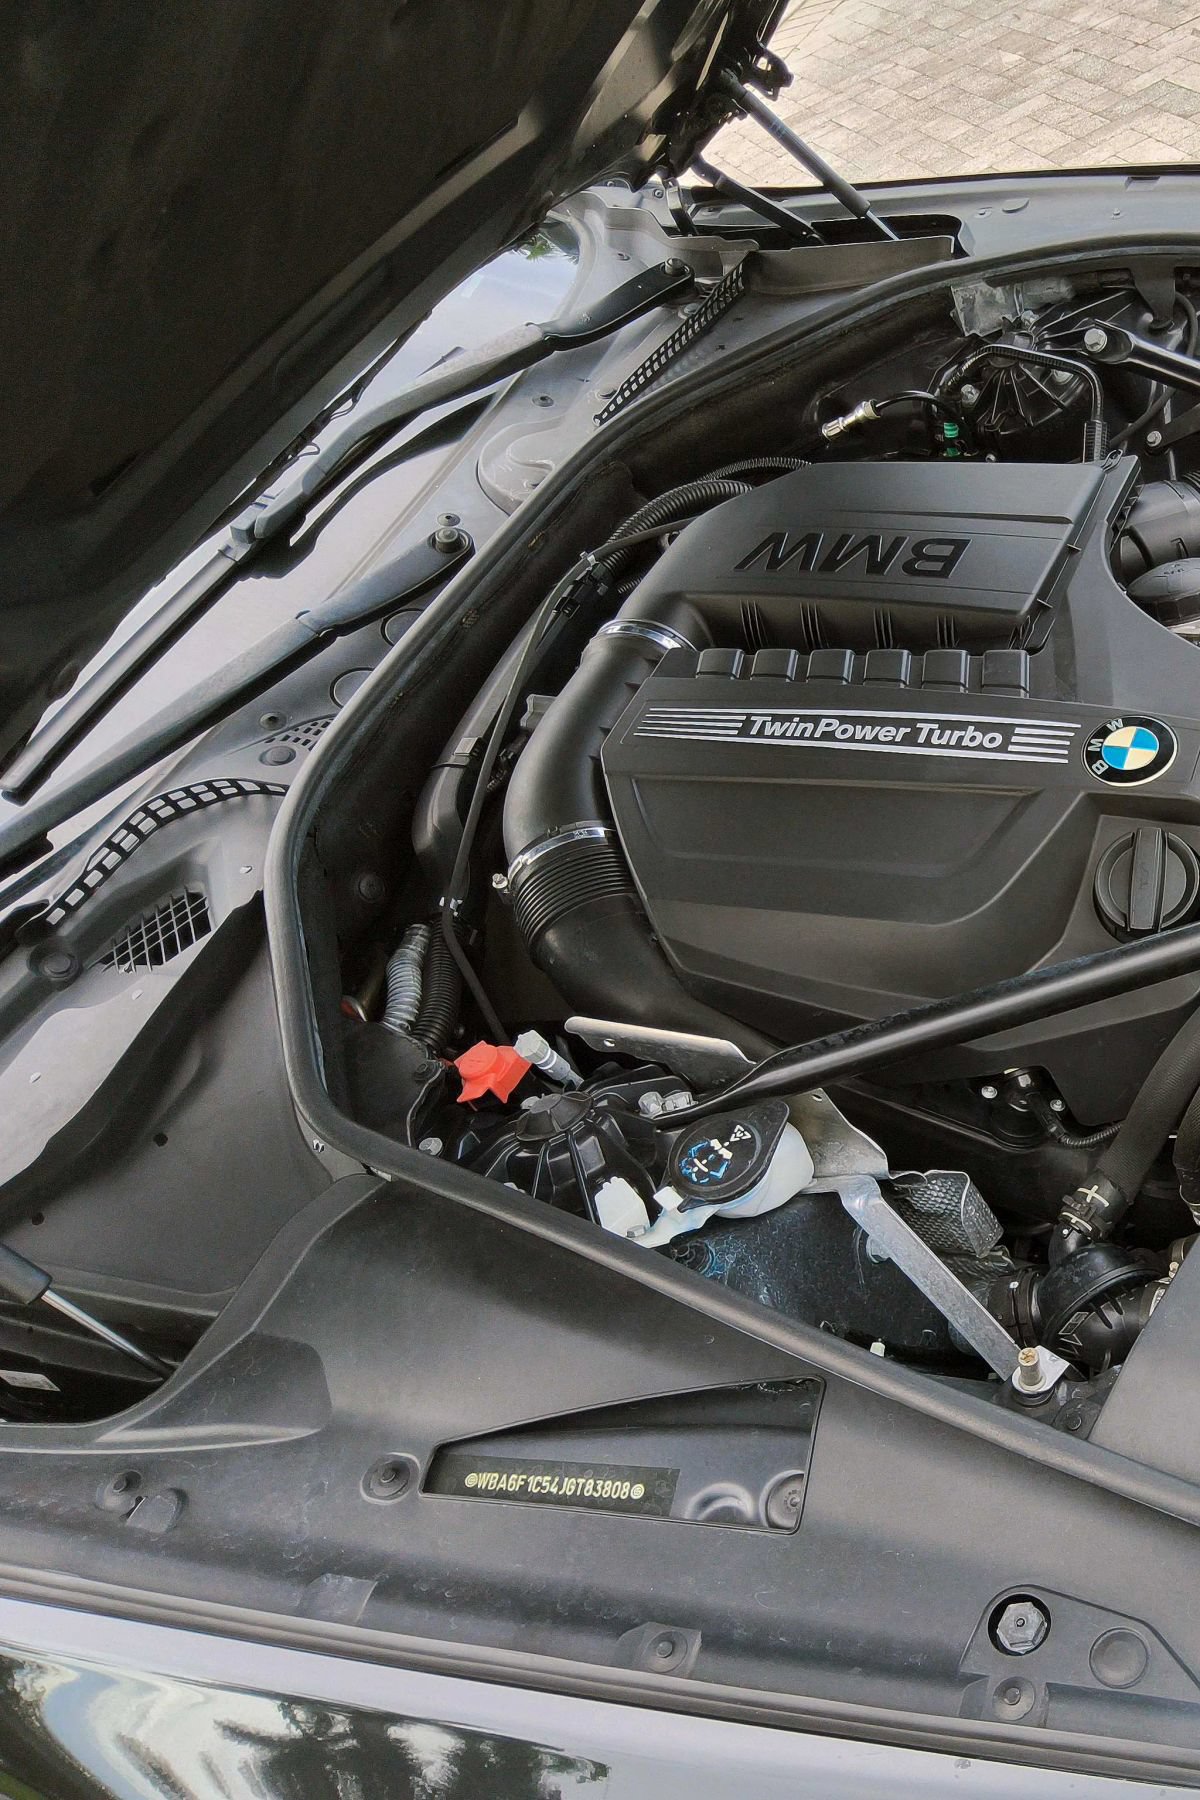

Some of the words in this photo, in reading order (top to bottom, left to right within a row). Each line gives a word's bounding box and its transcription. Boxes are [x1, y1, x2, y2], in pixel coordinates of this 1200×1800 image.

[734, 532, 972, 578] BMW
[916, 723, 1002, 749] Turbo
[1087, 718, 1124, 775] BMW
[477, 1472, 631, 1499] WBA6F1C54JGT83808
